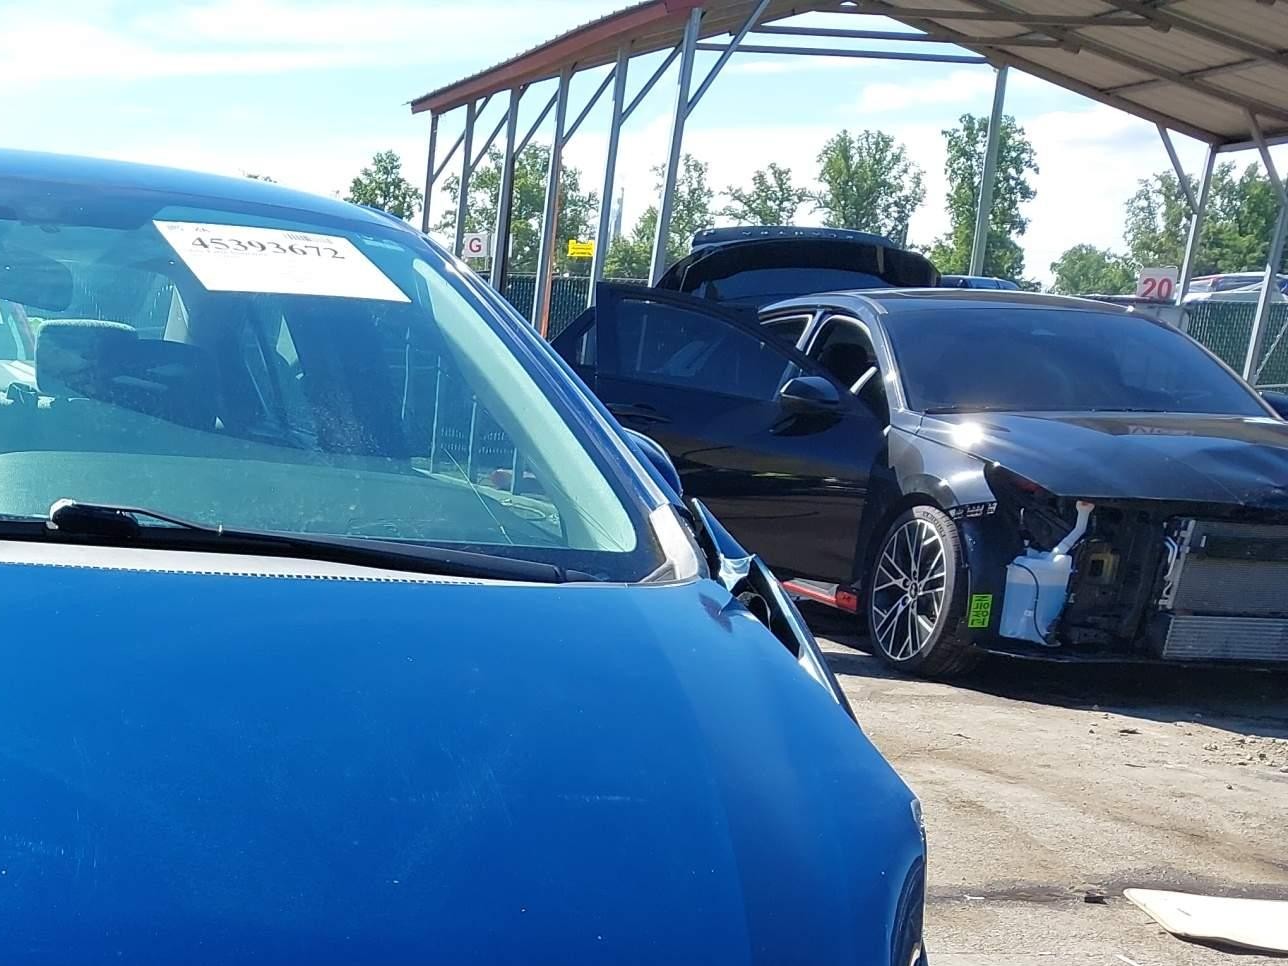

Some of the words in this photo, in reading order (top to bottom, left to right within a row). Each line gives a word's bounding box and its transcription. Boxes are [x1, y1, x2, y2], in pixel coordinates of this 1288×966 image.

[191, 236, 347, 260] 45393672
[469, 237, 482, 253] G
[1141, 277, 1173, 299] 20
